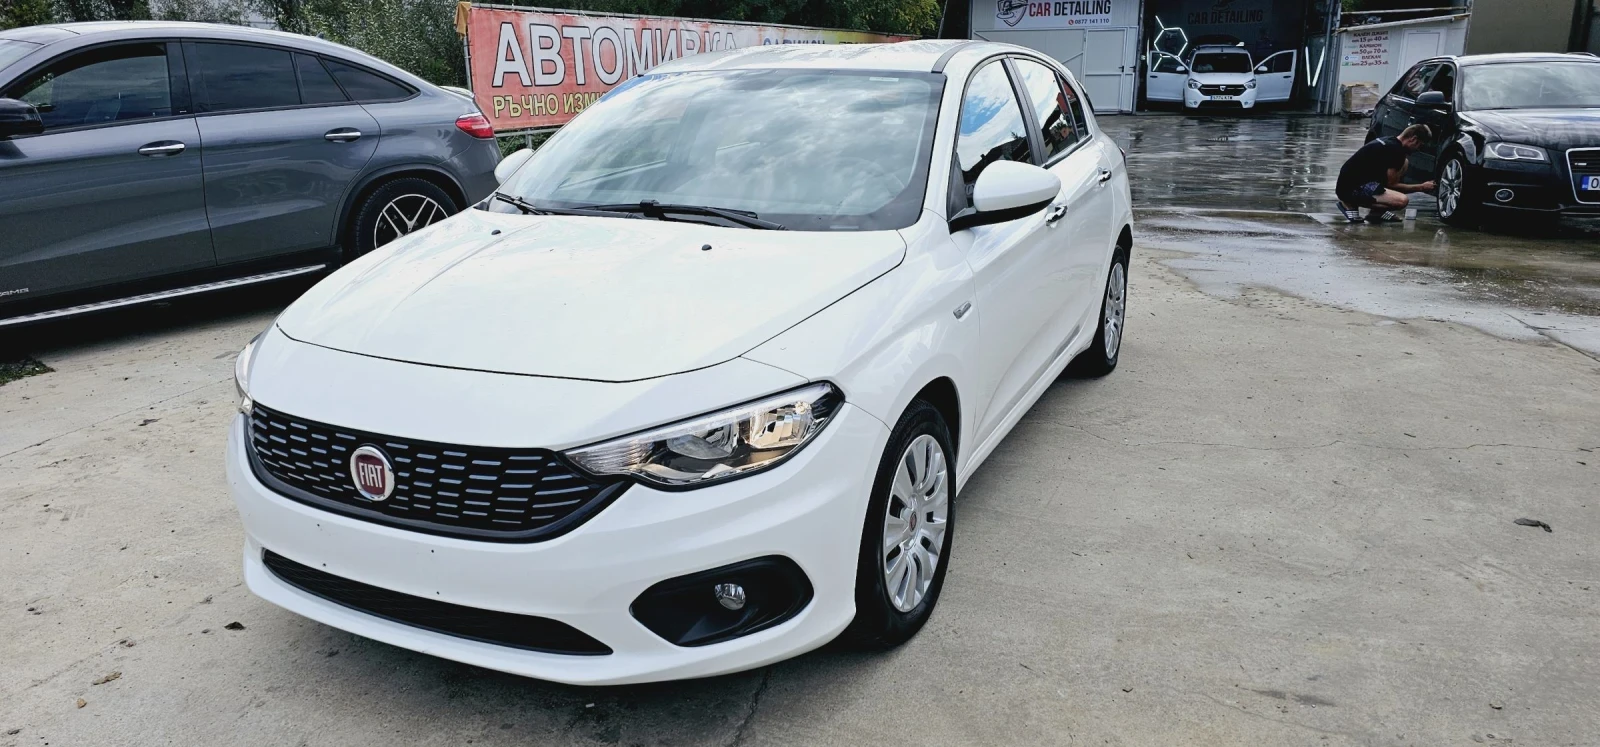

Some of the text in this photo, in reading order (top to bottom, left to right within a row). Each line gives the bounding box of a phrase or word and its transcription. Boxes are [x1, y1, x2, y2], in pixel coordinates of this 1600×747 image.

[1029, 0, 1111, 17] CAR DETAILING
[1187, 9, 1264, 25] CAR DETAILING
[493, 93, 559, 118] РЪЧНО
[358, 462, 383, 488] FIAT
